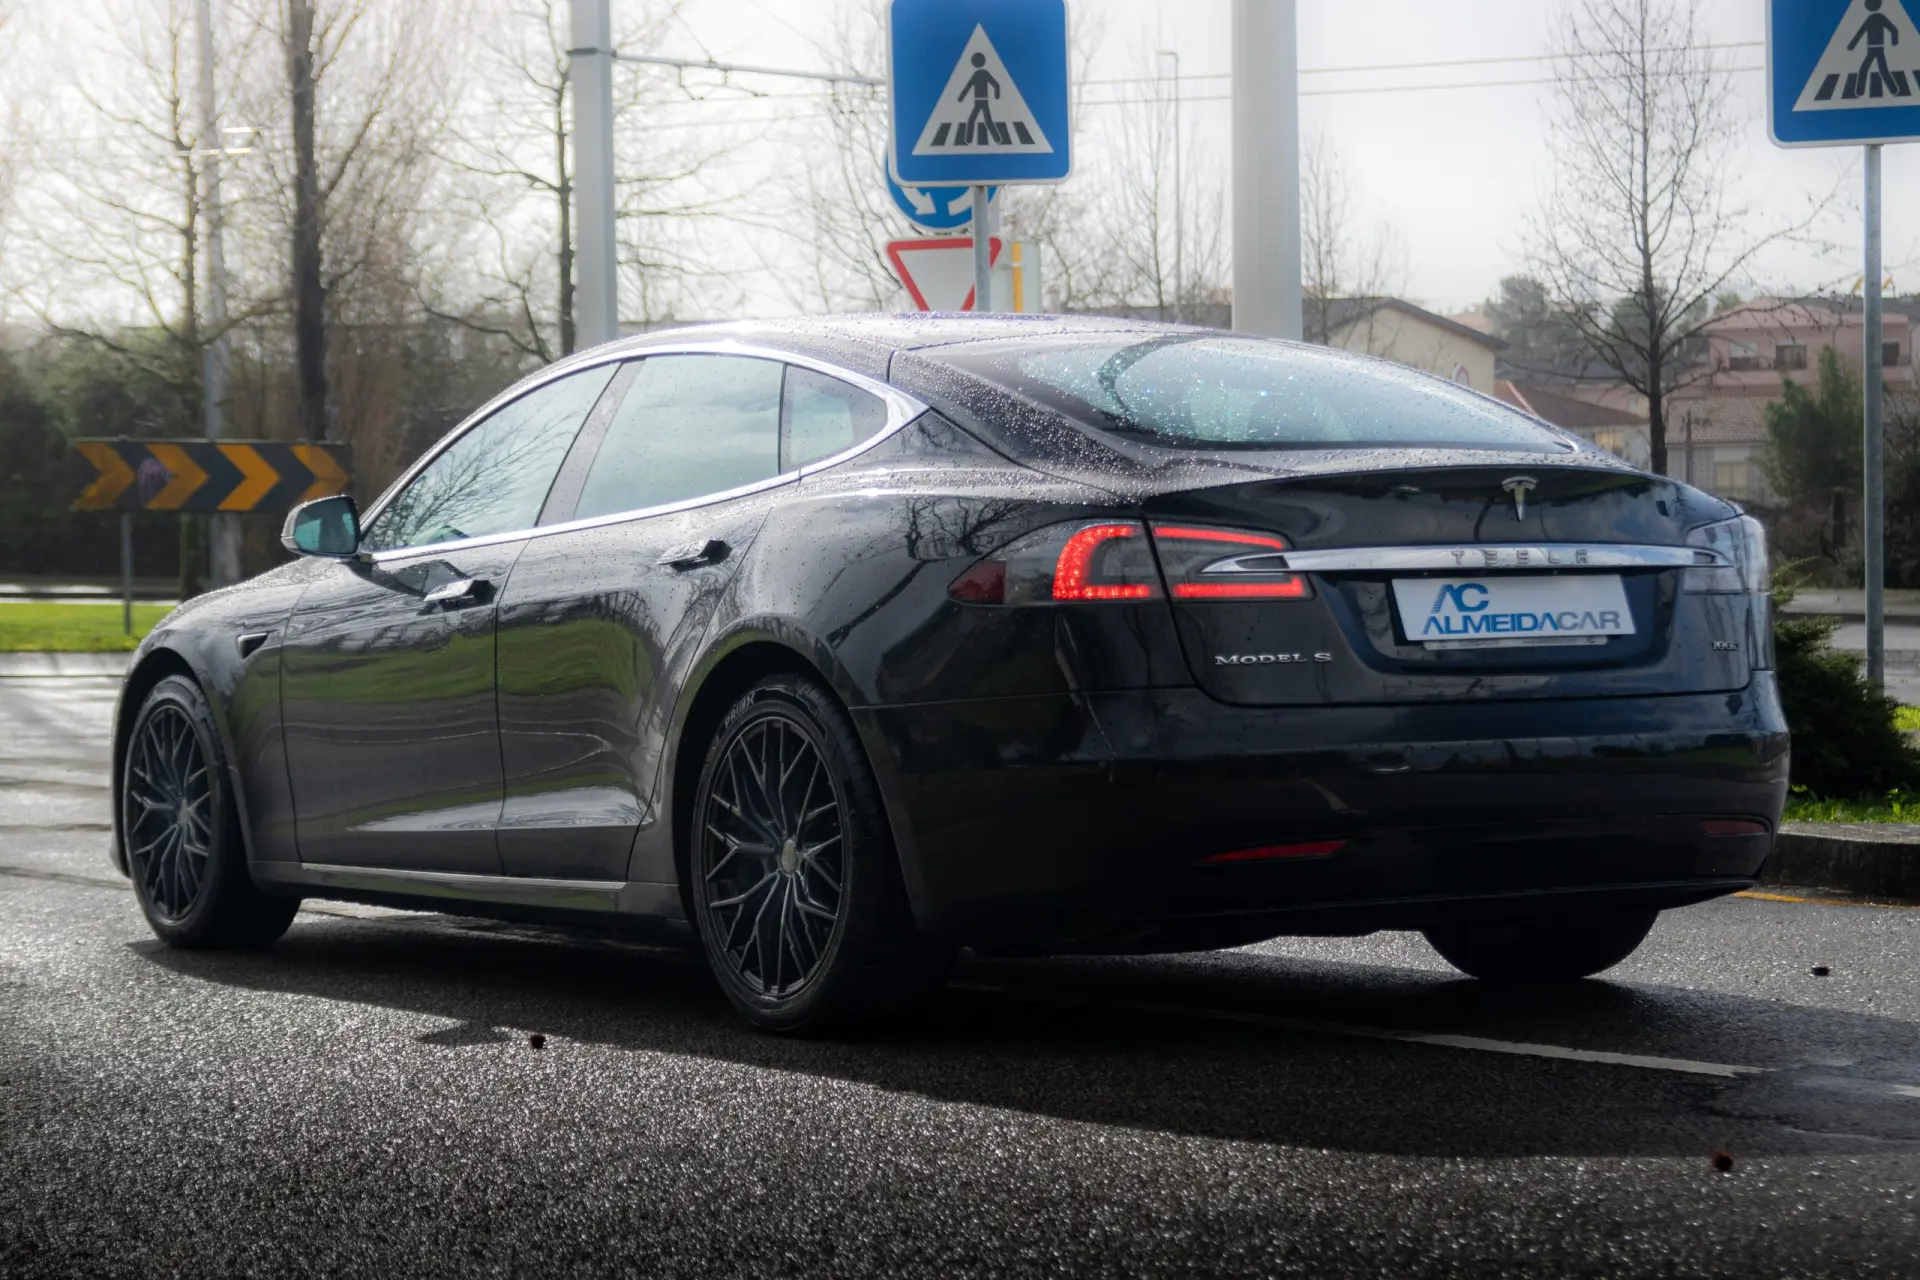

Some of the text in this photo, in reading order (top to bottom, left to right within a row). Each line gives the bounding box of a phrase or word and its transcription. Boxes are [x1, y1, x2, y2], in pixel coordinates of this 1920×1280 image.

[1451, 549, 1588, 567] TESLA
[1430, 582, 1489, 614] AC
[1422, 610, 1621, 636] ALMEIDACAR
[1214, 652, 1332, 666] MODEL S
